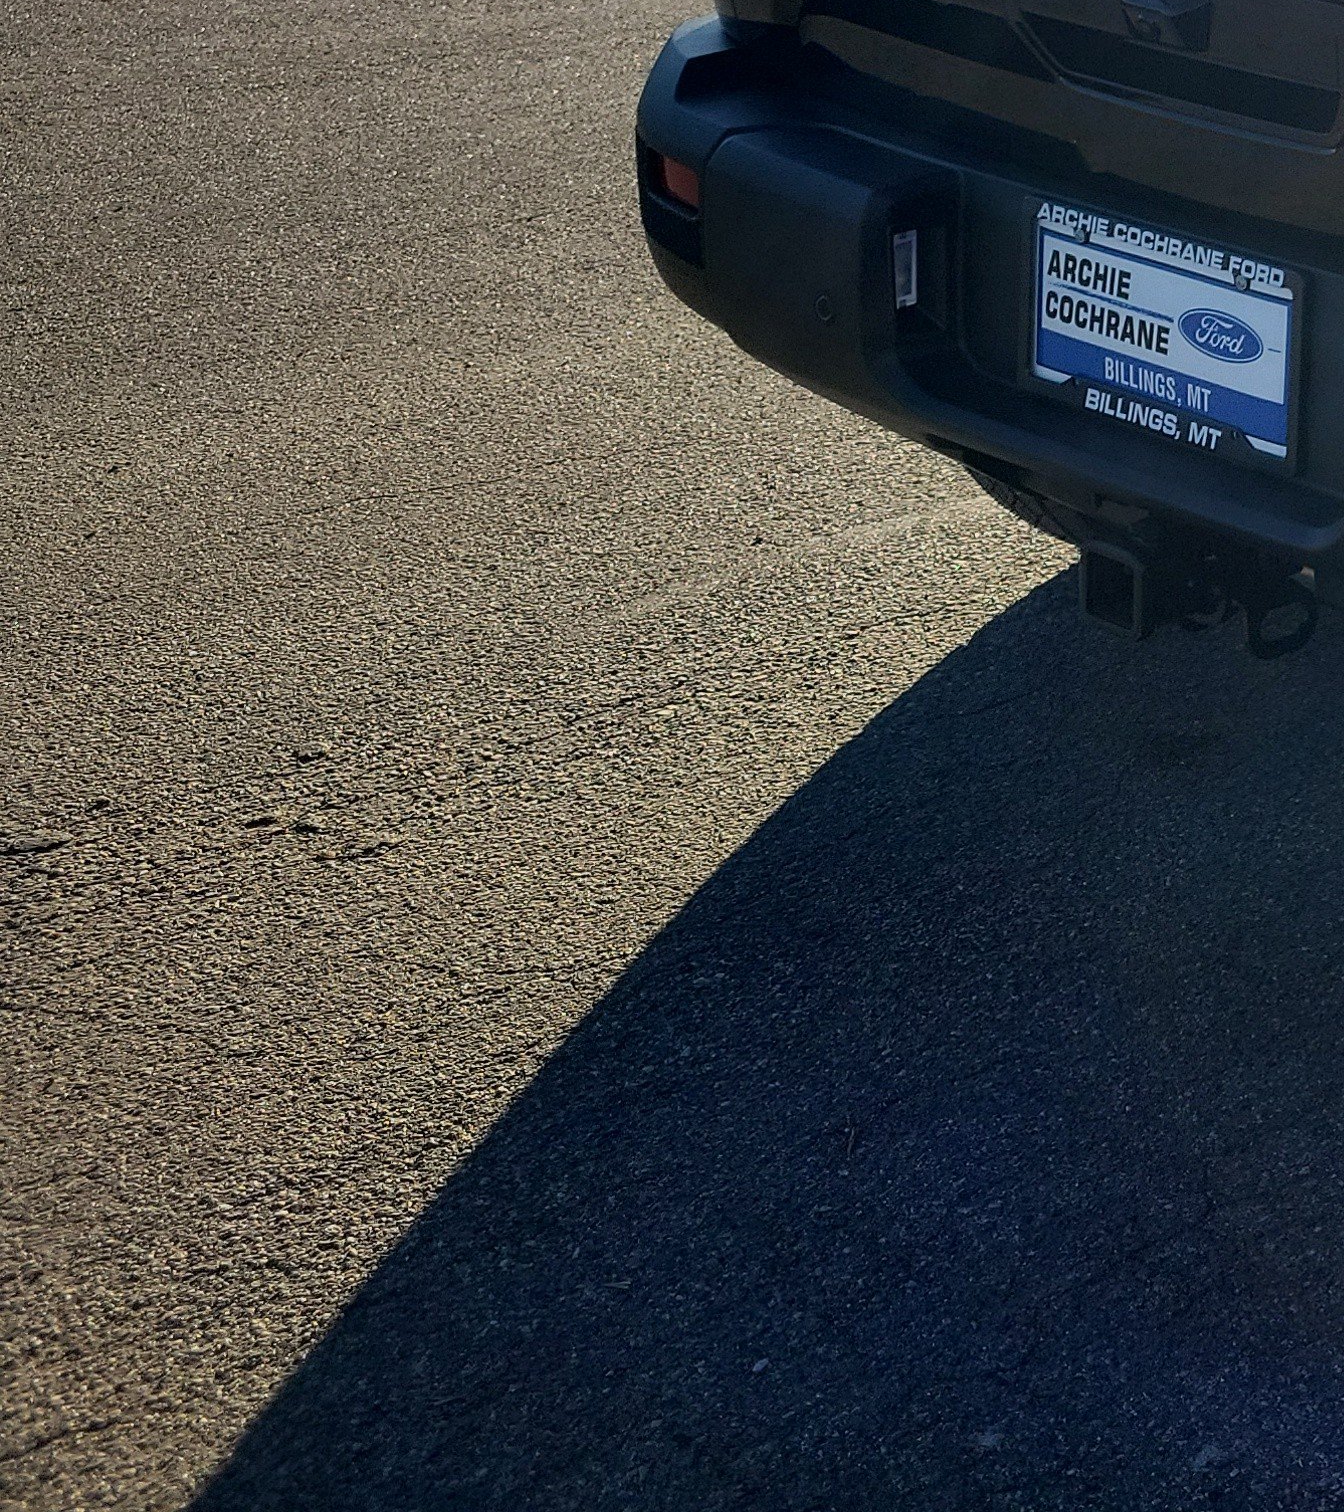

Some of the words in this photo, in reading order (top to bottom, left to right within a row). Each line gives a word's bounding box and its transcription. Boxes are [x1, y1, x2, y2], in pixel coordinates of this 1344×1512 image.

[1036, 202, 1110, 238] ARCHIE
[1113, 223, 1224, 271] COCHRANE
[1227, 255, 1286, 288] FORD
[1047, 249, 1132, 301] ARCHIE
[1044, 290, 1171, 357] COCHRANE
[1195, 314, 1246, 356] Ford
[1104, 356, 1182, 408] BILLINGS,
[1186, 383, 1212, 414] MT
[1084, 387, 1182, 440] BILLINGS,
[1187, 422, 1222, 451] MT
